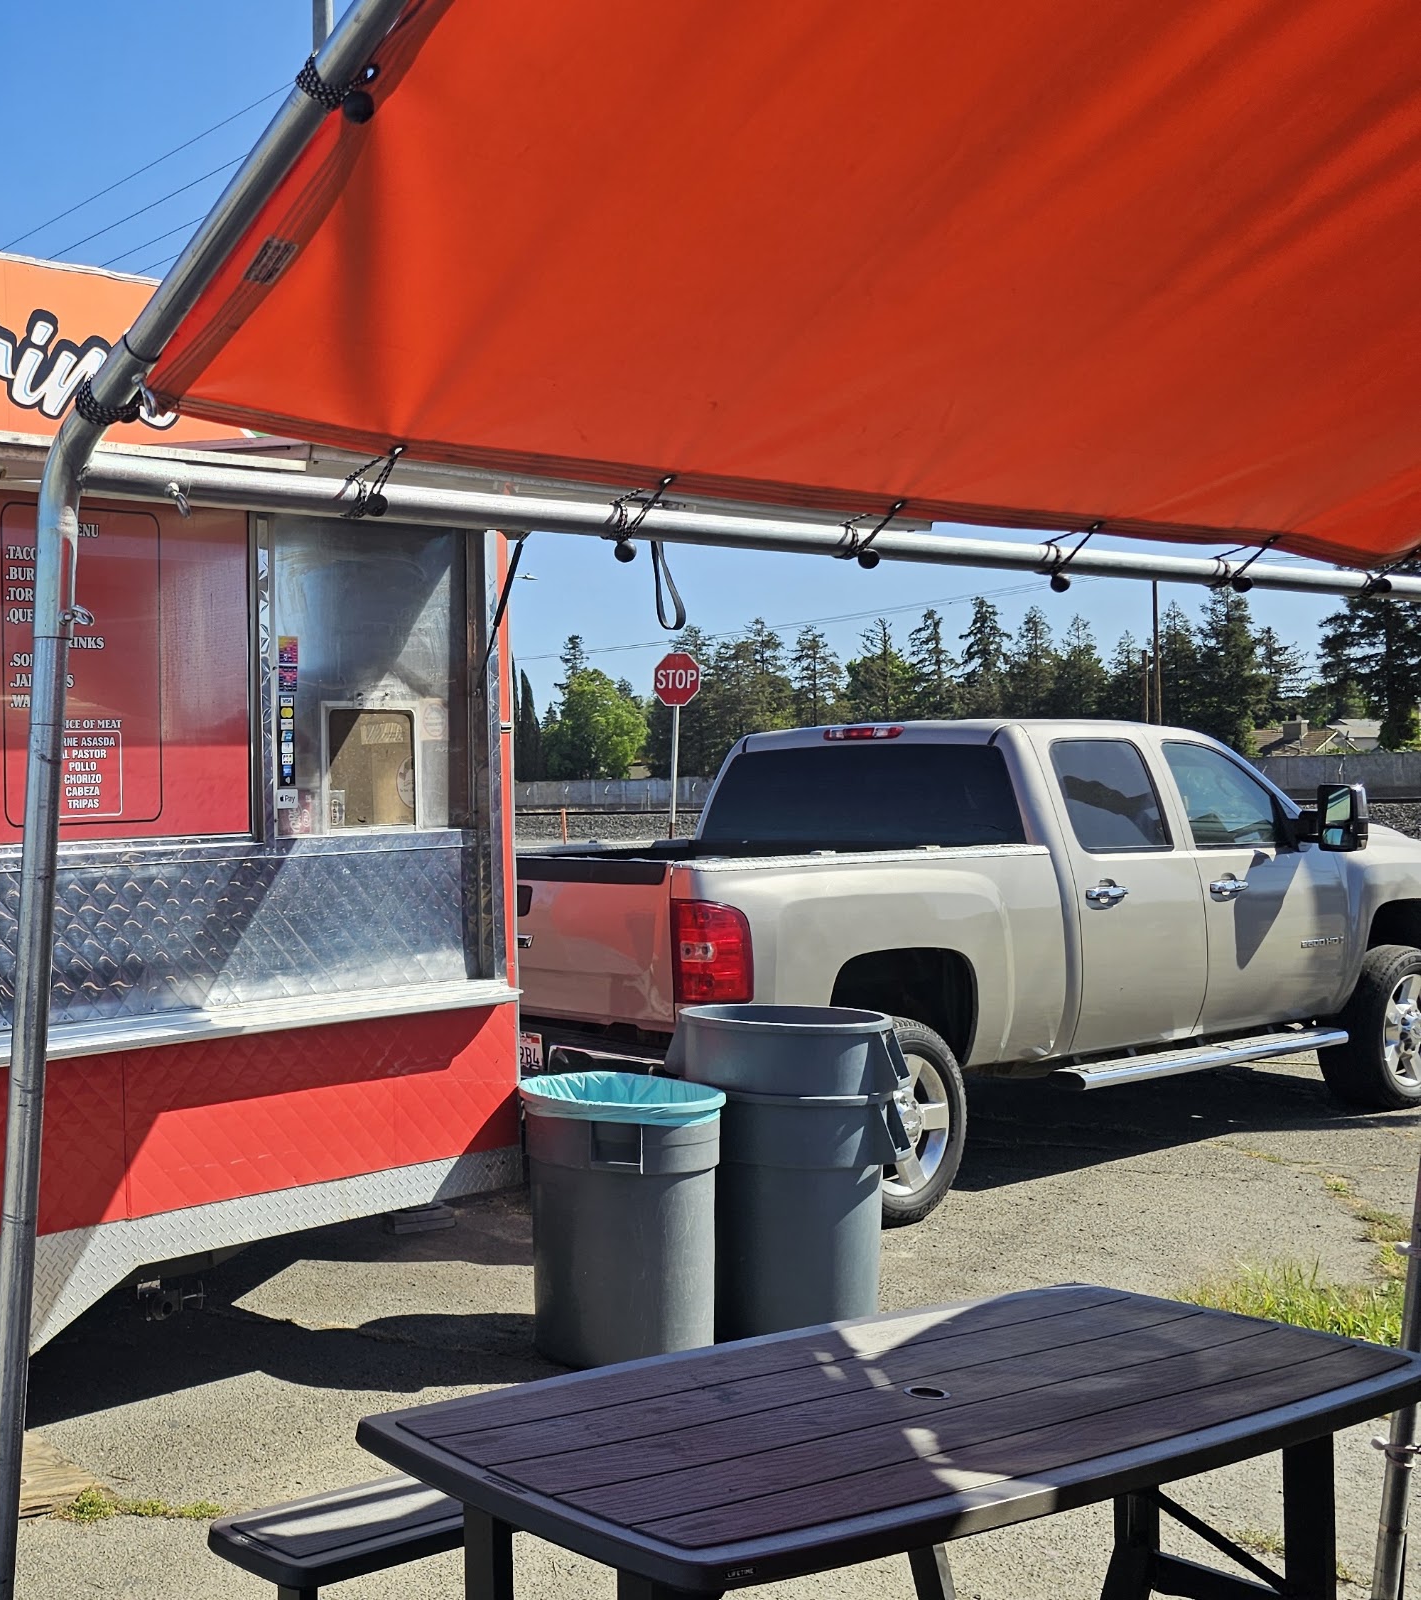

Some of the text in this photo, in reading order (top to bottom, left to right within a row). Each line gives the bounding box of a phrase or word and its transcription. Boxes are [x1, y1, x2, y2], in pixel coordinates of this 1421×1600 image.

[78, 523, 99, 538] ENU
[656, 669, 697, 689] STOP
[82, 719, 96, 729] OF
[97, 719, 123, 729] MEAT
[63, 737, 115, 747] RNE ASASDA
[72, 749, 107, 759] PASTOR
[68, 762, 97, 772] POLLO
[64, 774, 102, 784] CHORIZO
[65, 786, 100, 797] CABEZA
[67, 799, 100, 809] TRIPAS
[284, 794, 296, 804] Pay
